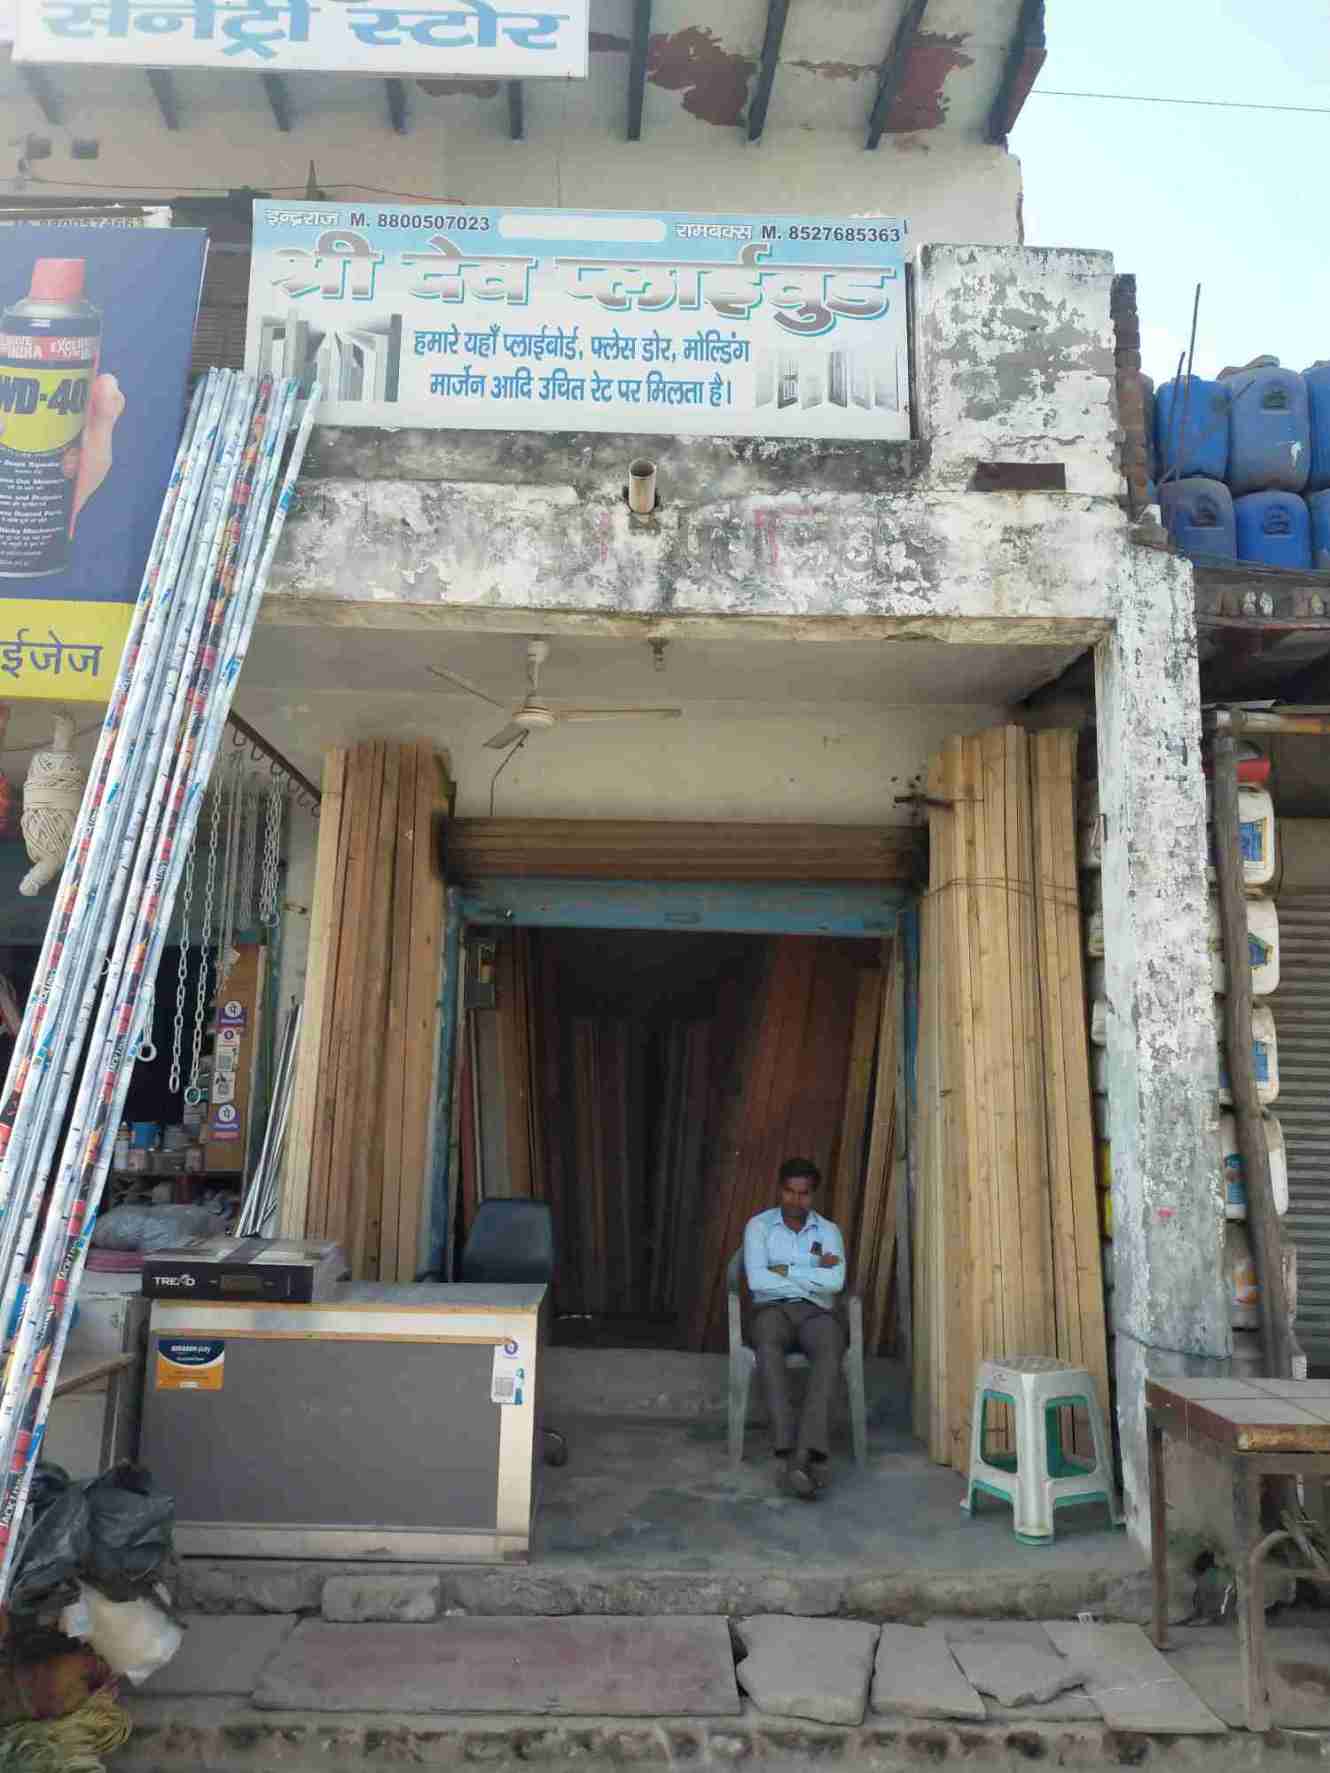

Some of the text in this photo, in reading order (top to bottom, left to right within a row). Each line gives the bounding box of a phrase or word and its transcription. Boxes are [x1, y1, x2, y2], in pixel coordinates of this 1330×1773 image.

[346, 0, 571, 49] स्टोर
[350, 212, 370, 227] M.
[377, 213, 490, 231] 8800507023
[762, 225, 781, 240] M.
[788, 225, 900, 242] 8527685363
[268, 230, 385, 300] श्री
[414, 322, 461, 355] हमारे
[463, 323, 501, 357] यहाँ
[640, 329, 677, 362] डोर,
[682, 329, 751, 363] मोल्डिंग
[490, 366, 534, 400] आदि
[538, 367, 586, 401] उचित
[591, 369, 614, 402] रेट
[616, 379, 643, 402] पर
[646, 369, 705, 405] मिलता
